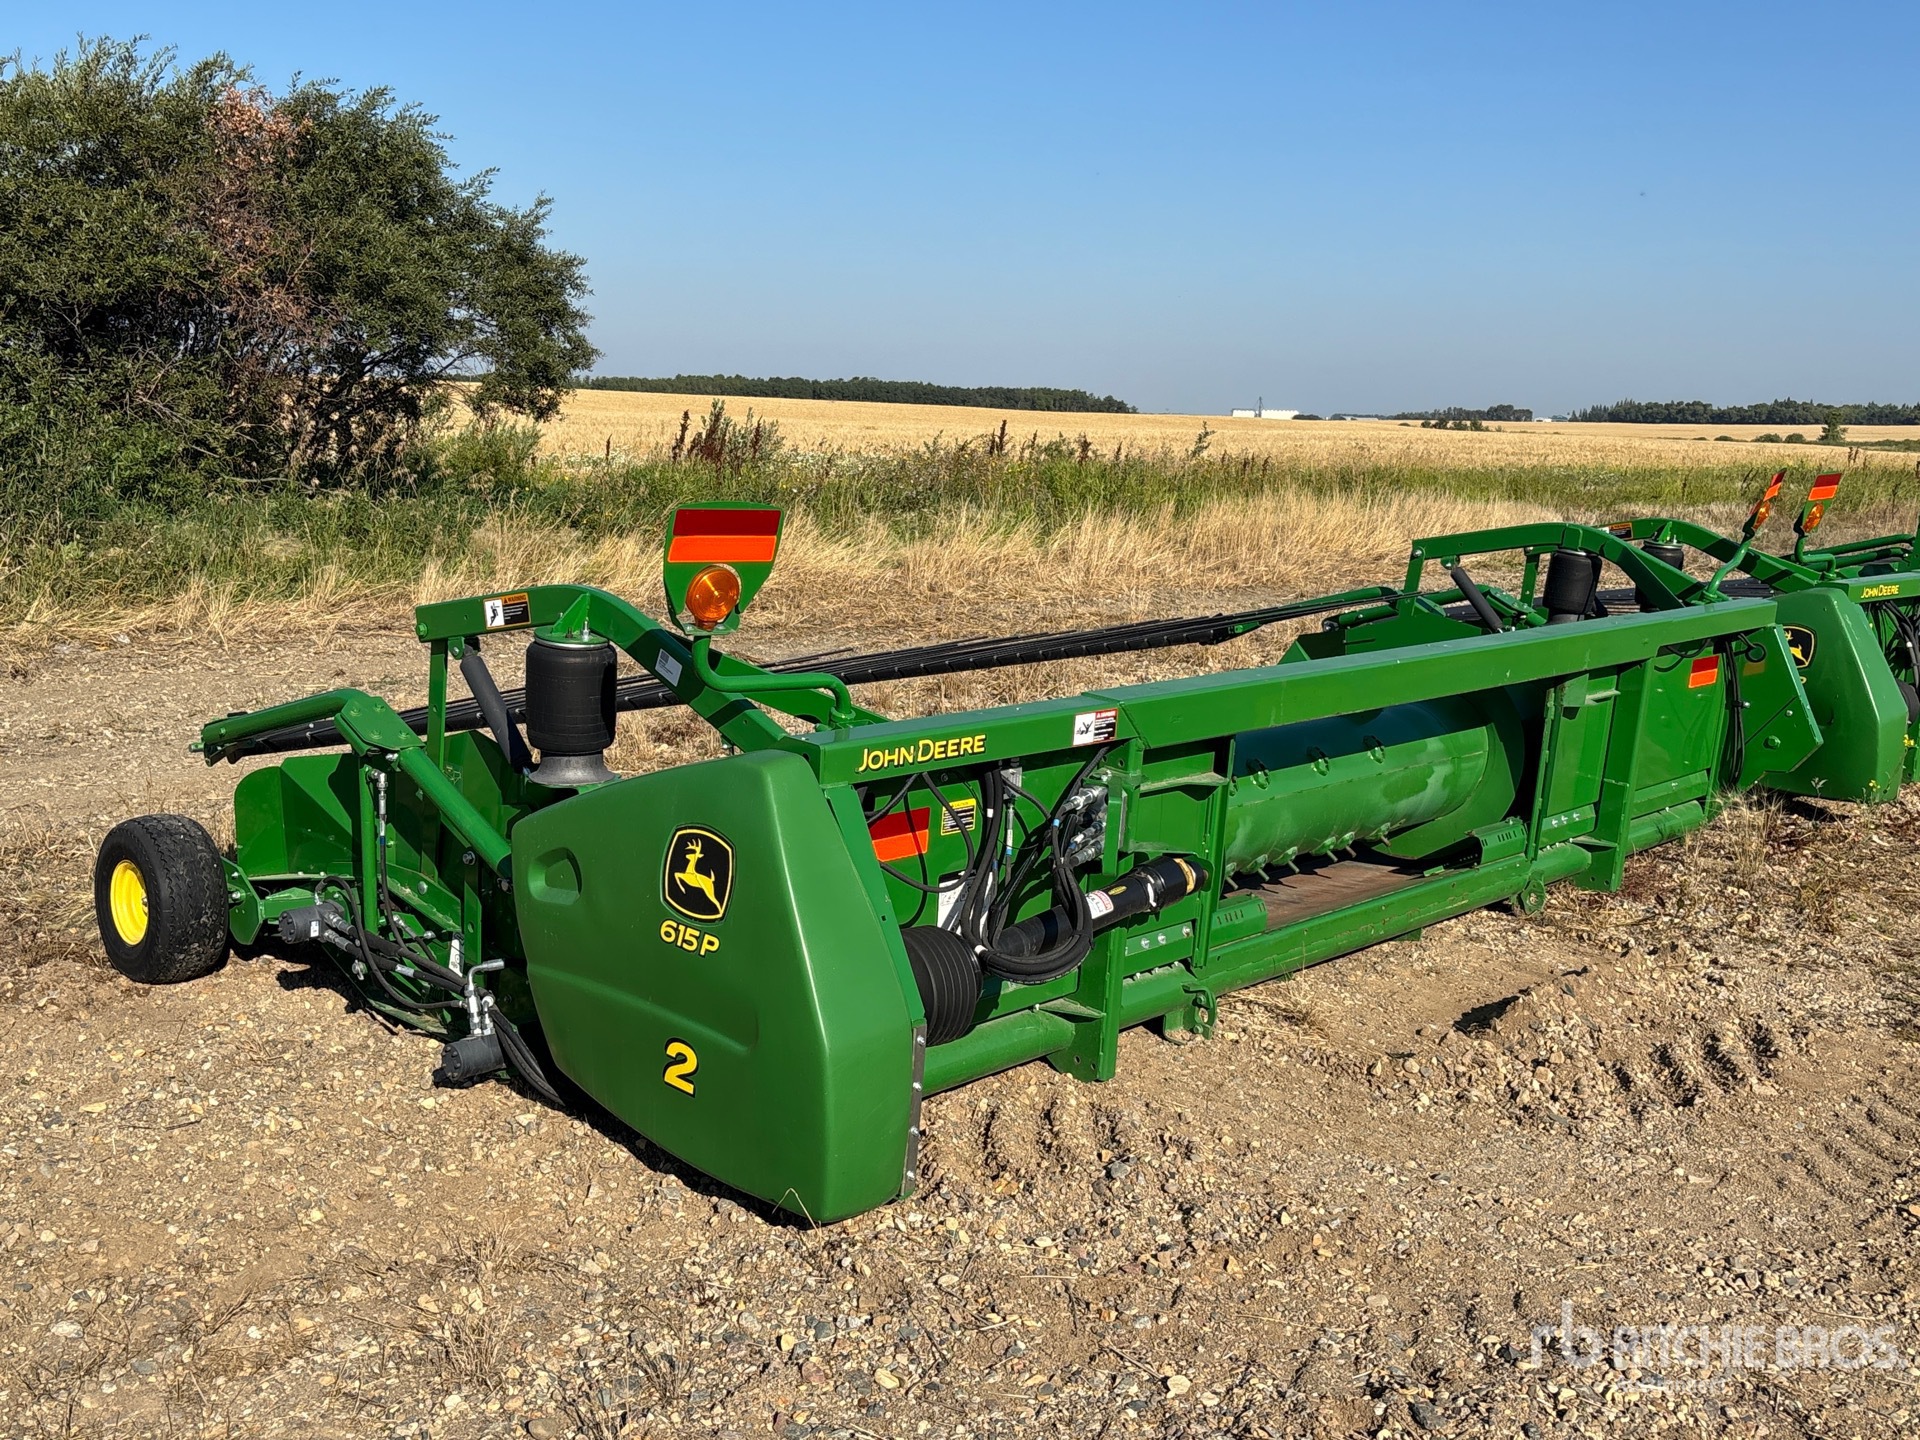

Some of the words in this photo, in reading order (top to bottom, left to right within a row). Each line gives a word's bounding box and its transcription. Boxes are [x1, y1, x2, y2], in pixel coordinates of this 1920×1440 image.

[1860, 587, 1879, 599] JOHN
[1879, 584, 1899, 596] DEERE
[857, 745, 915, 773] JOHN
[917, 734, 987, 763] DEERE
[659, 919, 720, 957] 615P
[663, 1038, 698, 1097] 2
